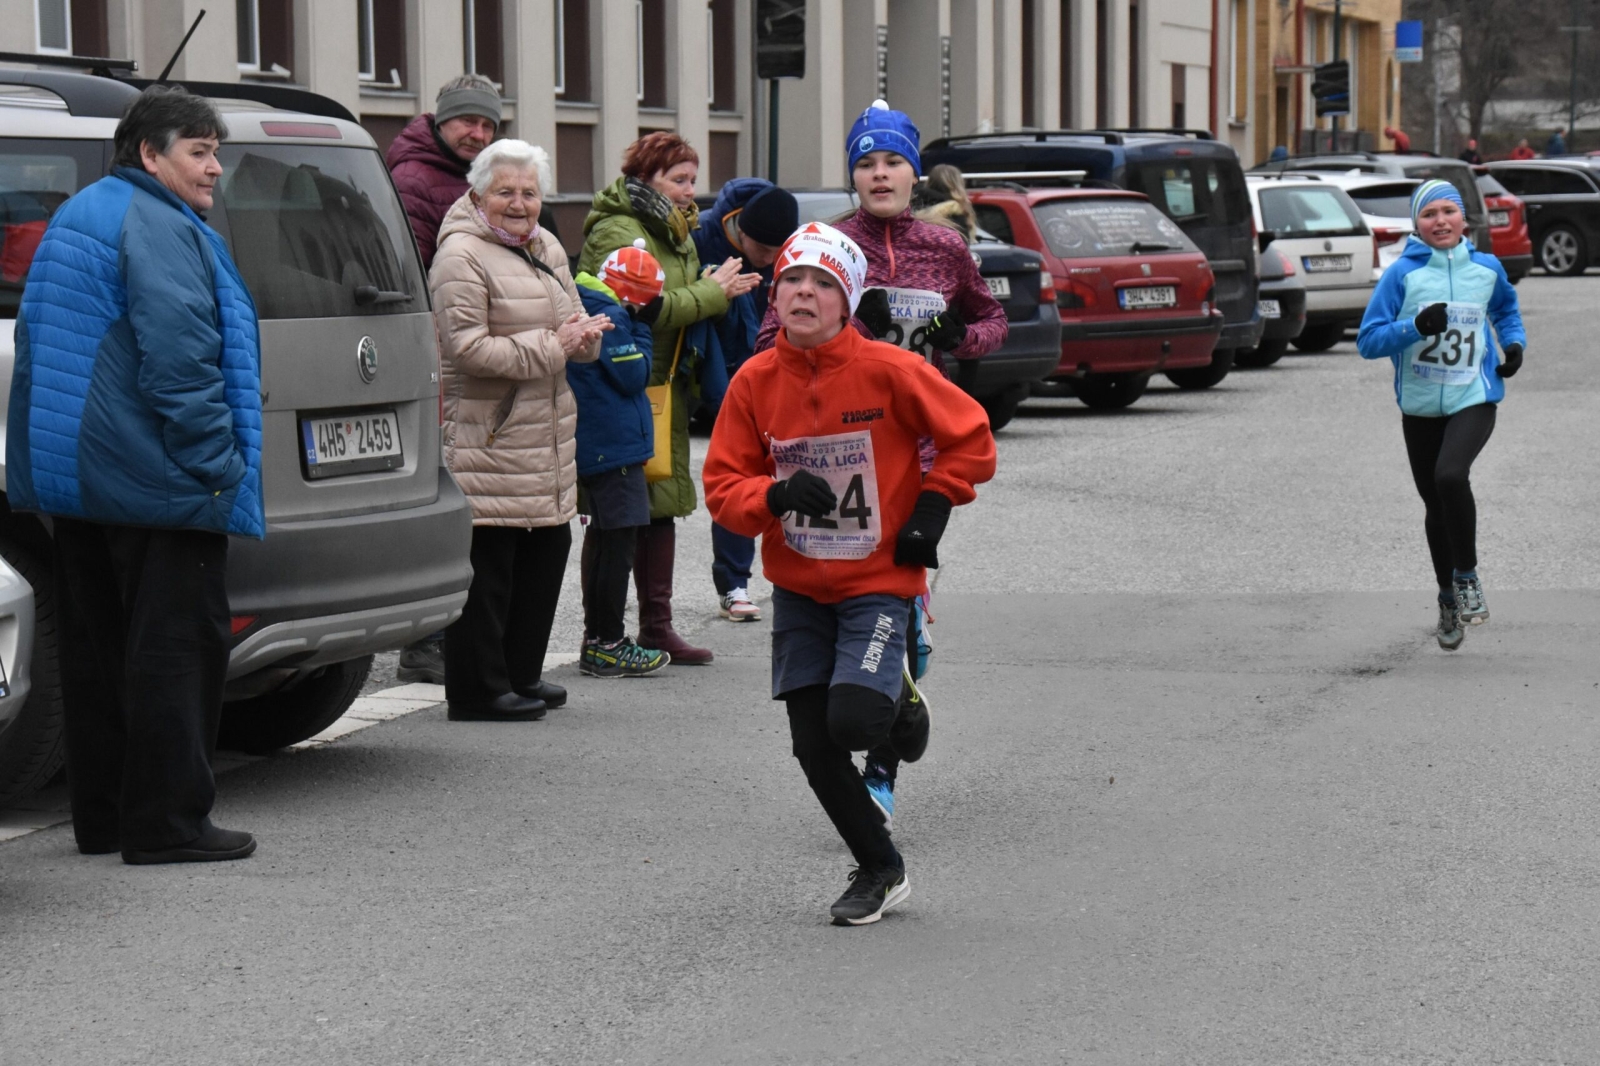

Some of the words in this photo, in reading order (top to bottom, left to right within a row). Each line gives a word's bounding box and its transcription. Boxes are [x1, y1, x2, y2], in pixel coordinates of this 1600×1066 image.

[1418, 329, 1475, 367] 231
[319, 422, 346, 458] 4H5
[355, 418, 393, 454] 2459
[771, 441, 809, 454] ZIMNÍ
[835, 451, 868, 467] LIGA
[860, 639, 886, 674] NAGEUR
